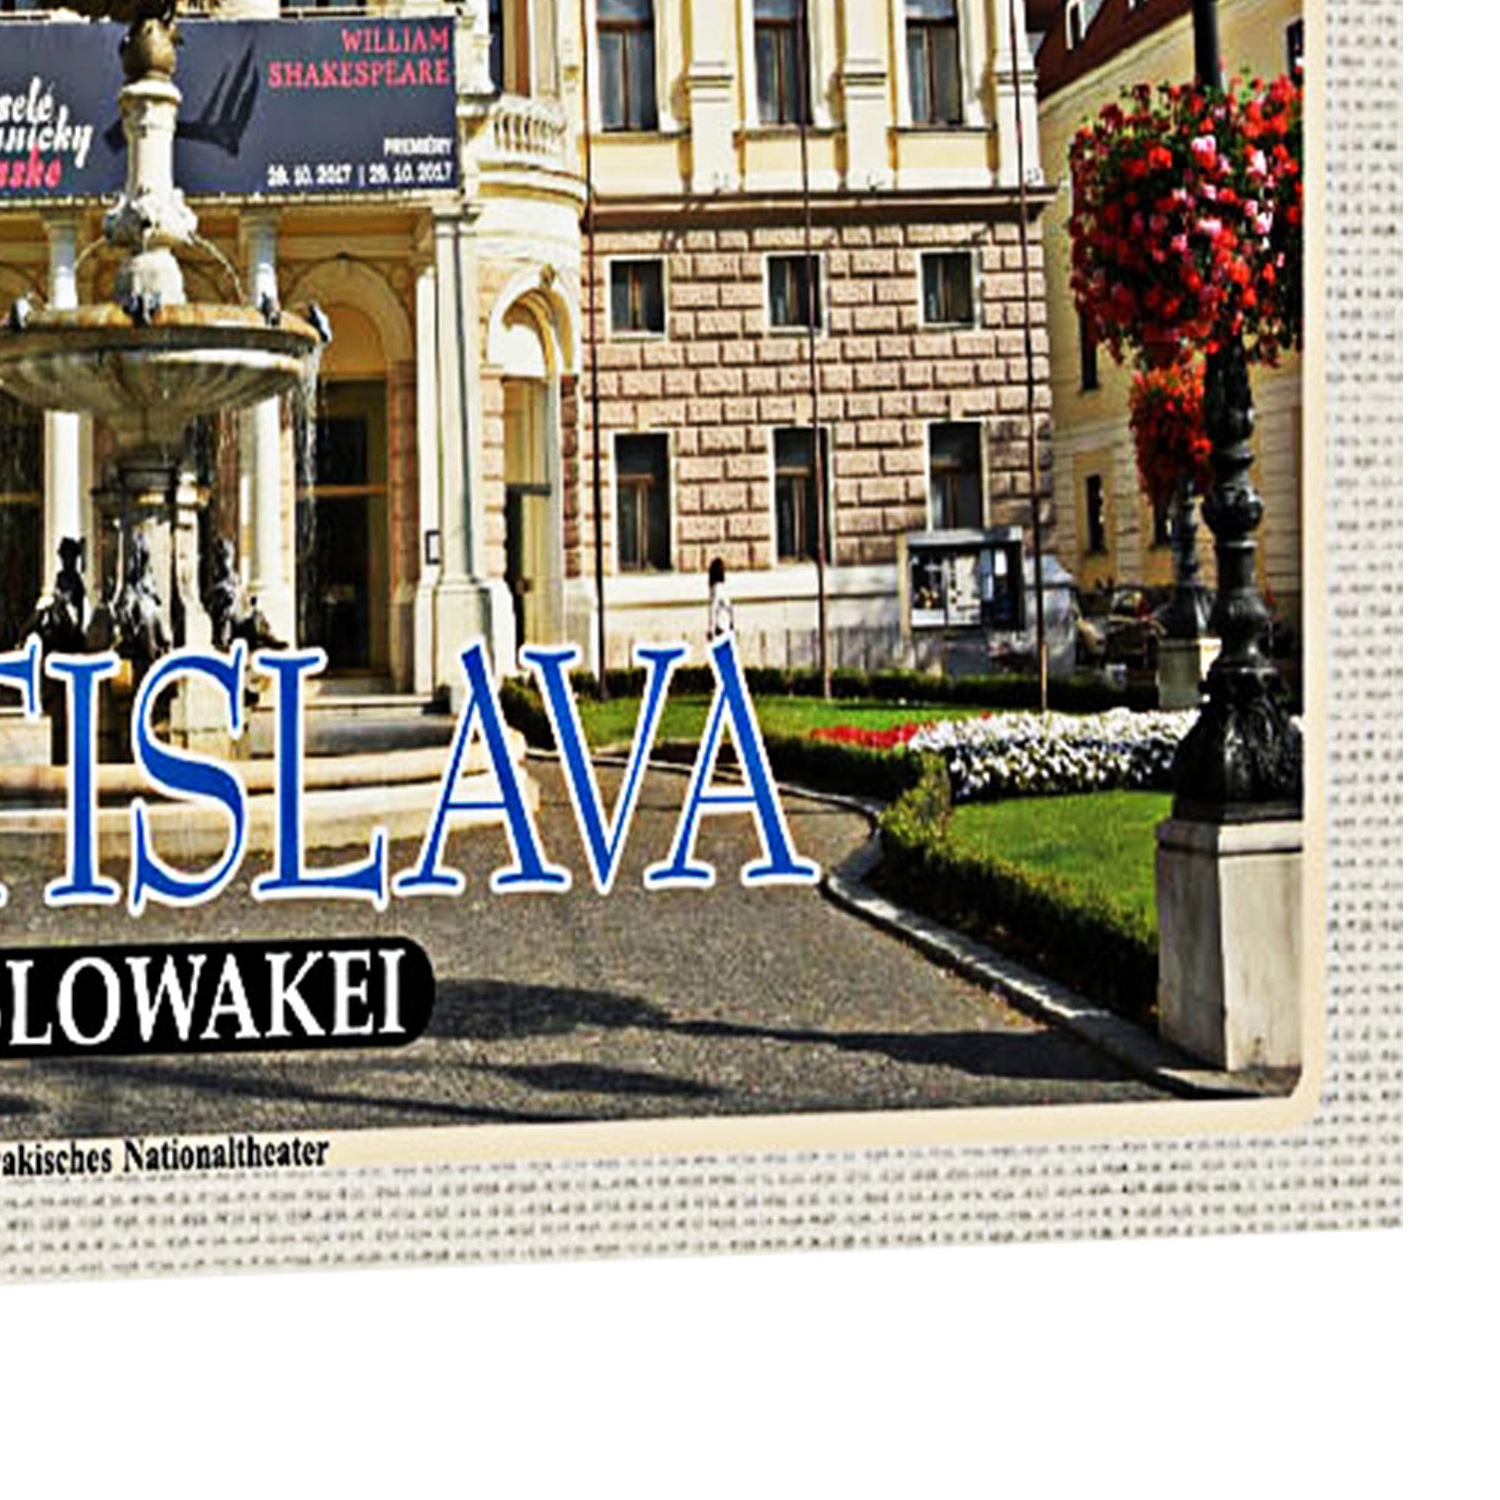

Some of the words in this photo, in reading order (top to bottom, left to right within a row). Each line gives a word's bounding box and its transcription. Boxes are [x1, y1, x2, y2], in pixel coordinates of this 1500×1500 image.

[341, 25, 449, 53] WILLIAM
[268, 59, 450, 88] SHAKESPEARE
[122, 1134, 330, 1173] Nationaltheater
